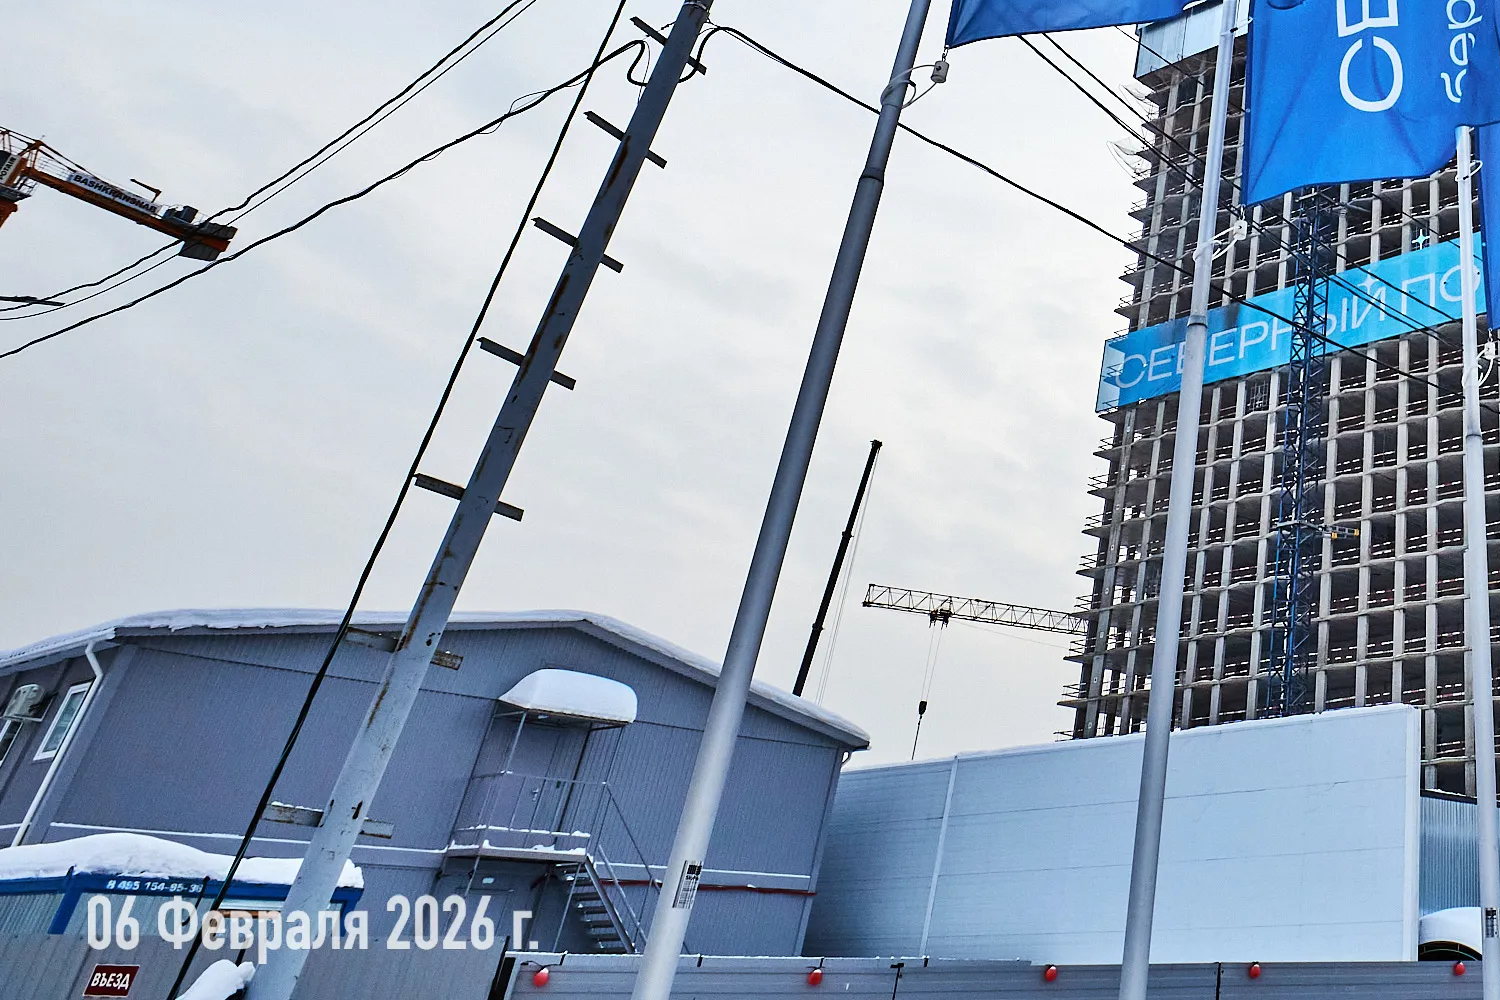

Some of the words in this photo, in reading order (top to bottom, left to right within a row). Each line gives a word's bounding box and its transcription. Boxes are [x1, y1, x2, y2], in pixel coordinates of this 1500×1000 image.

[73, 175, 158, 213] BASHKRANSNAB
[1115, 275, 1387, 389] СЕЕРНЫЙ
[90, 972, 131, 990] ВЪЕЗД
